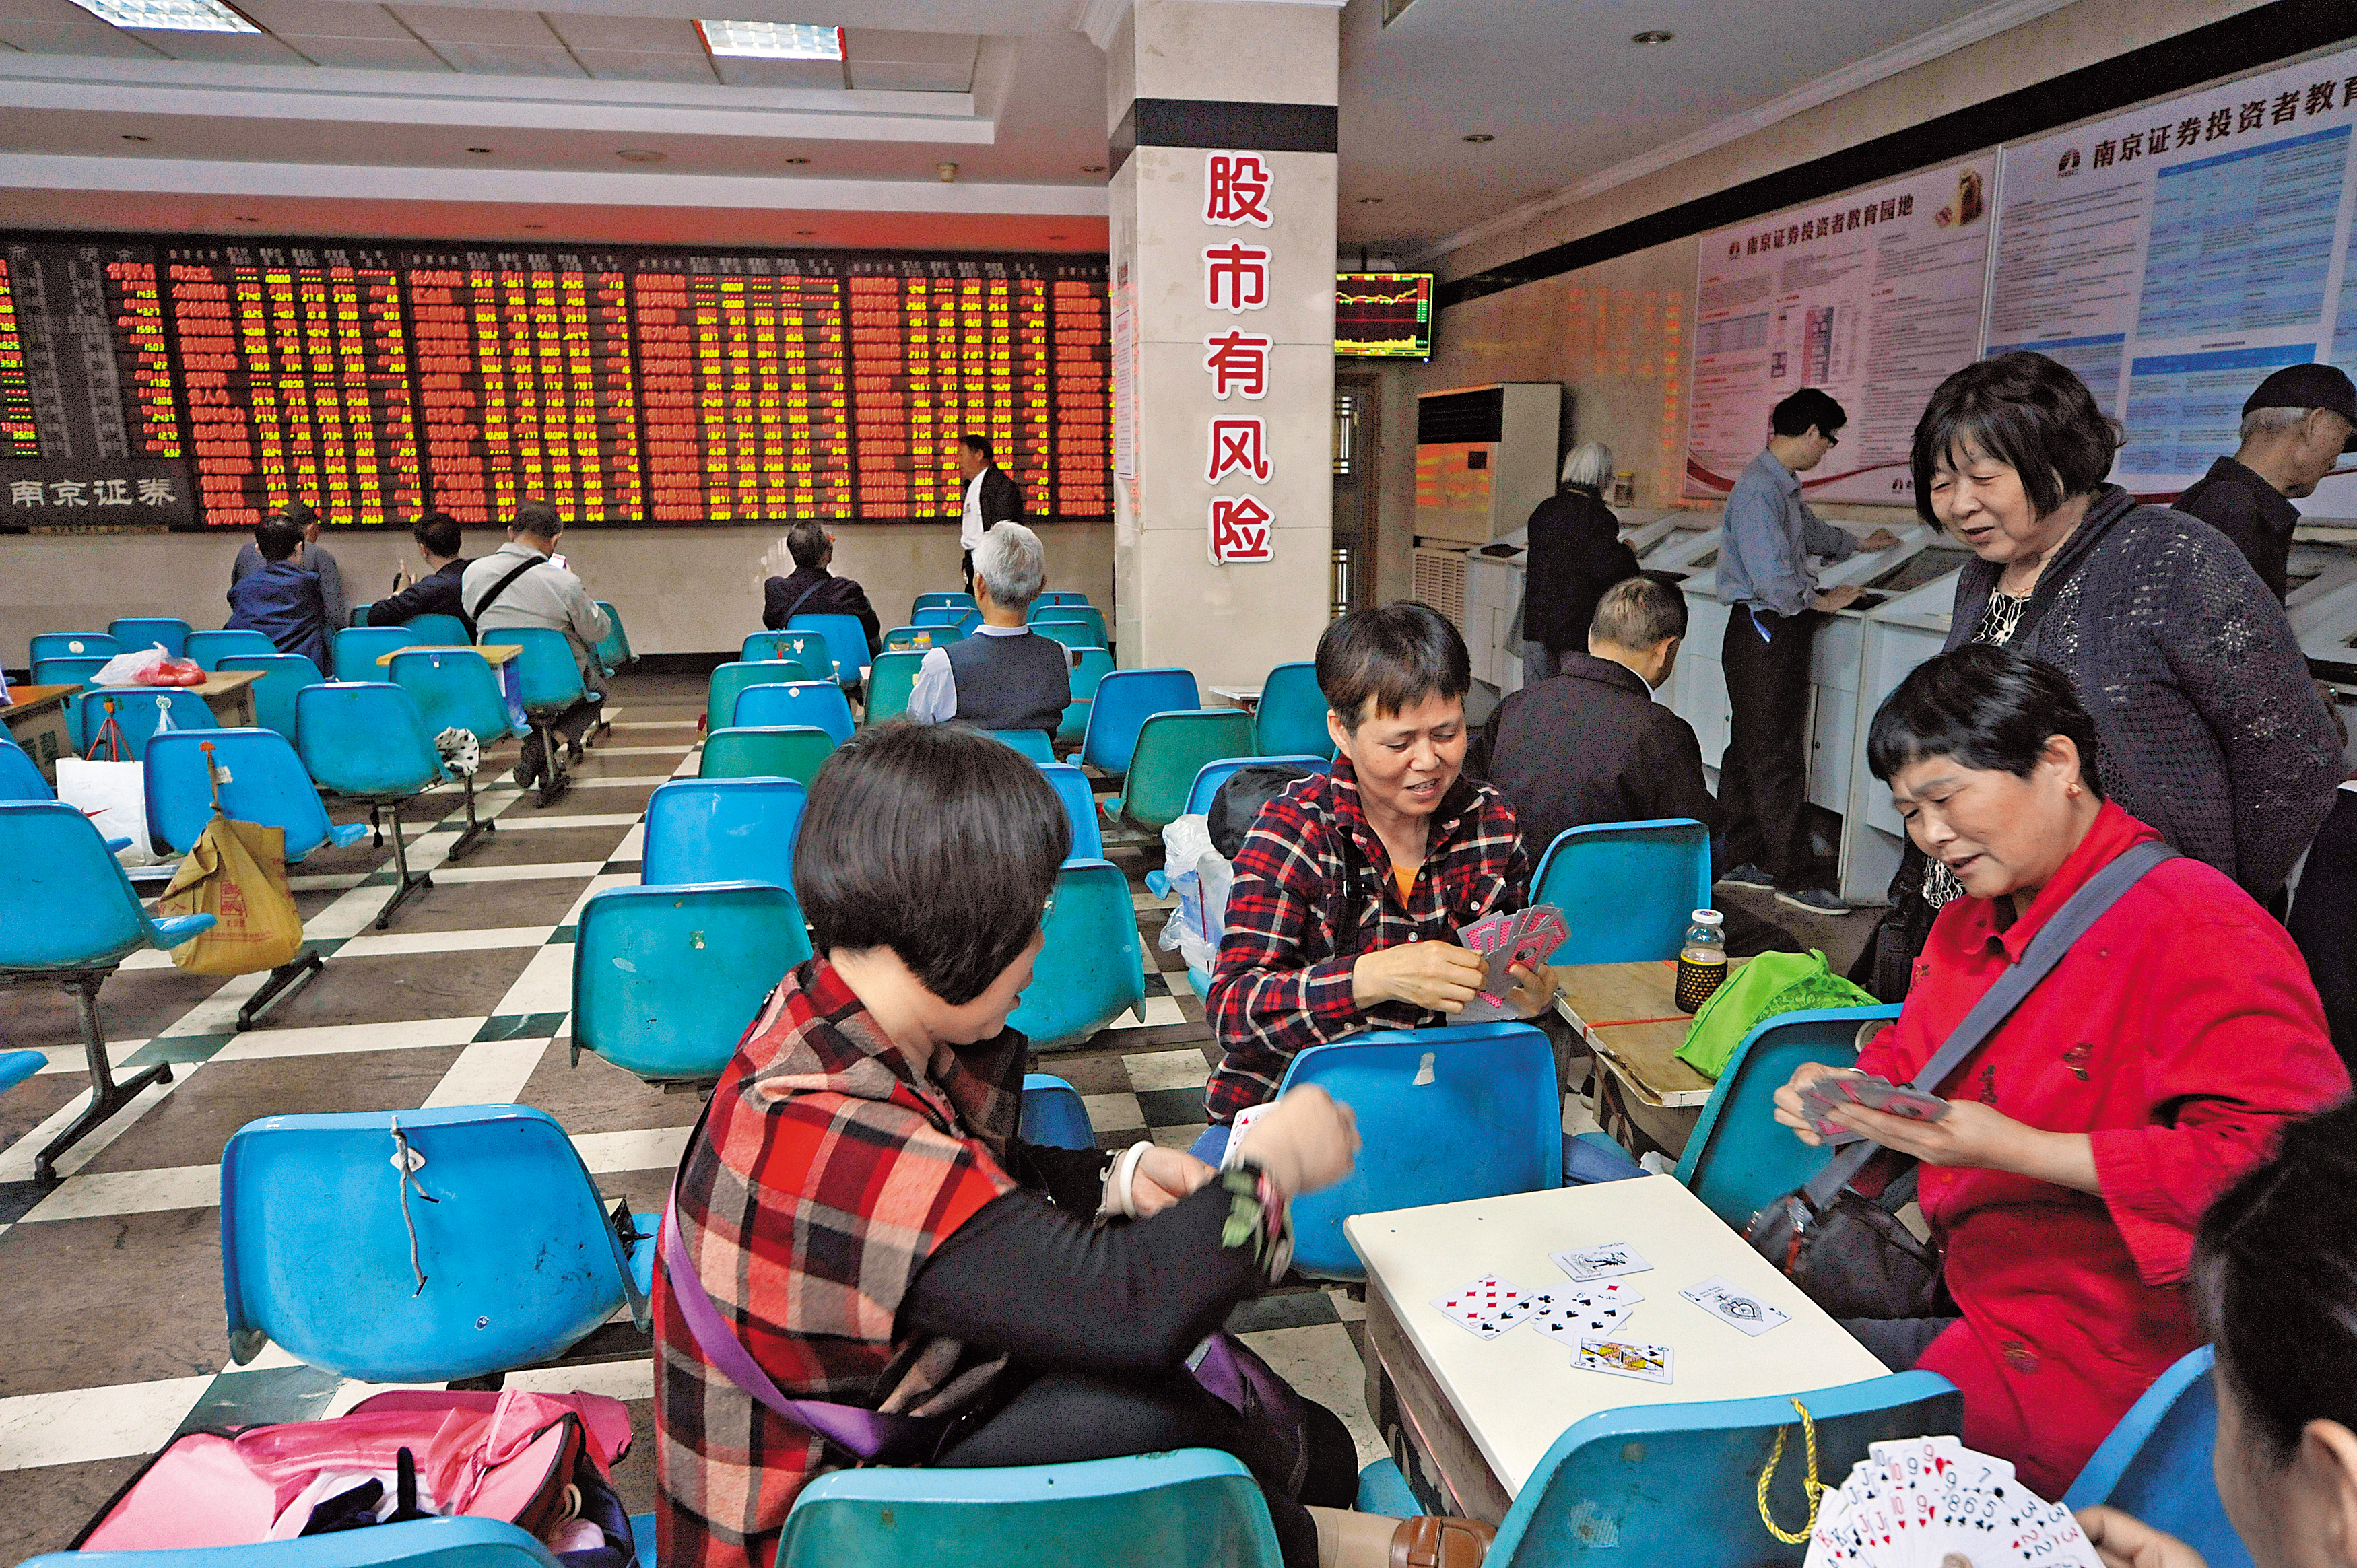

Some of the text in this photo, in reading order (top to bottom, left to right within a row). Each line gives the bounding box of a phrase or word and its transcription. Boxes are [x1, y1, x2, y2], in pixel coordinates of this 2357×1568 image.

[1746, 193, 1914, 256] 南京证券投资者教育园地
[170, 265, 213, 281] 司太立
[409, 270, 465, 287] 长久物流
[1205, 156, 1270, 561] 股市有风险
[187, 389, 230, 405] 贵人鸟
[10, 479, 177, 507] 南京证券
[205, 509, 262, 525] 伟明环保
[1924, 1444, 1933, 1462] 9
[1907, 1457, 1918, 1474] 9
[1979, 1466, 1992, 1482] 7
[1946, 1472, 1956, 1489] 9
[1917, 1495, 1927, 1513] 9
[1964, 1497, 1977, 1513] 6
[1982, 1499, 1997, 1518] 5
[2021, 1501, 2037, 1518] 3
[1876, 1511, 1885, 1530] J
[2048, 1507, 2065, 1523] 3
[1859, 1515, 1869, 1533] J
[2021, 1529, 2038, 1544] 2
[2061, 1526, 2079, 1542] 3
[2035, 1541, 2052, 1556] 2
